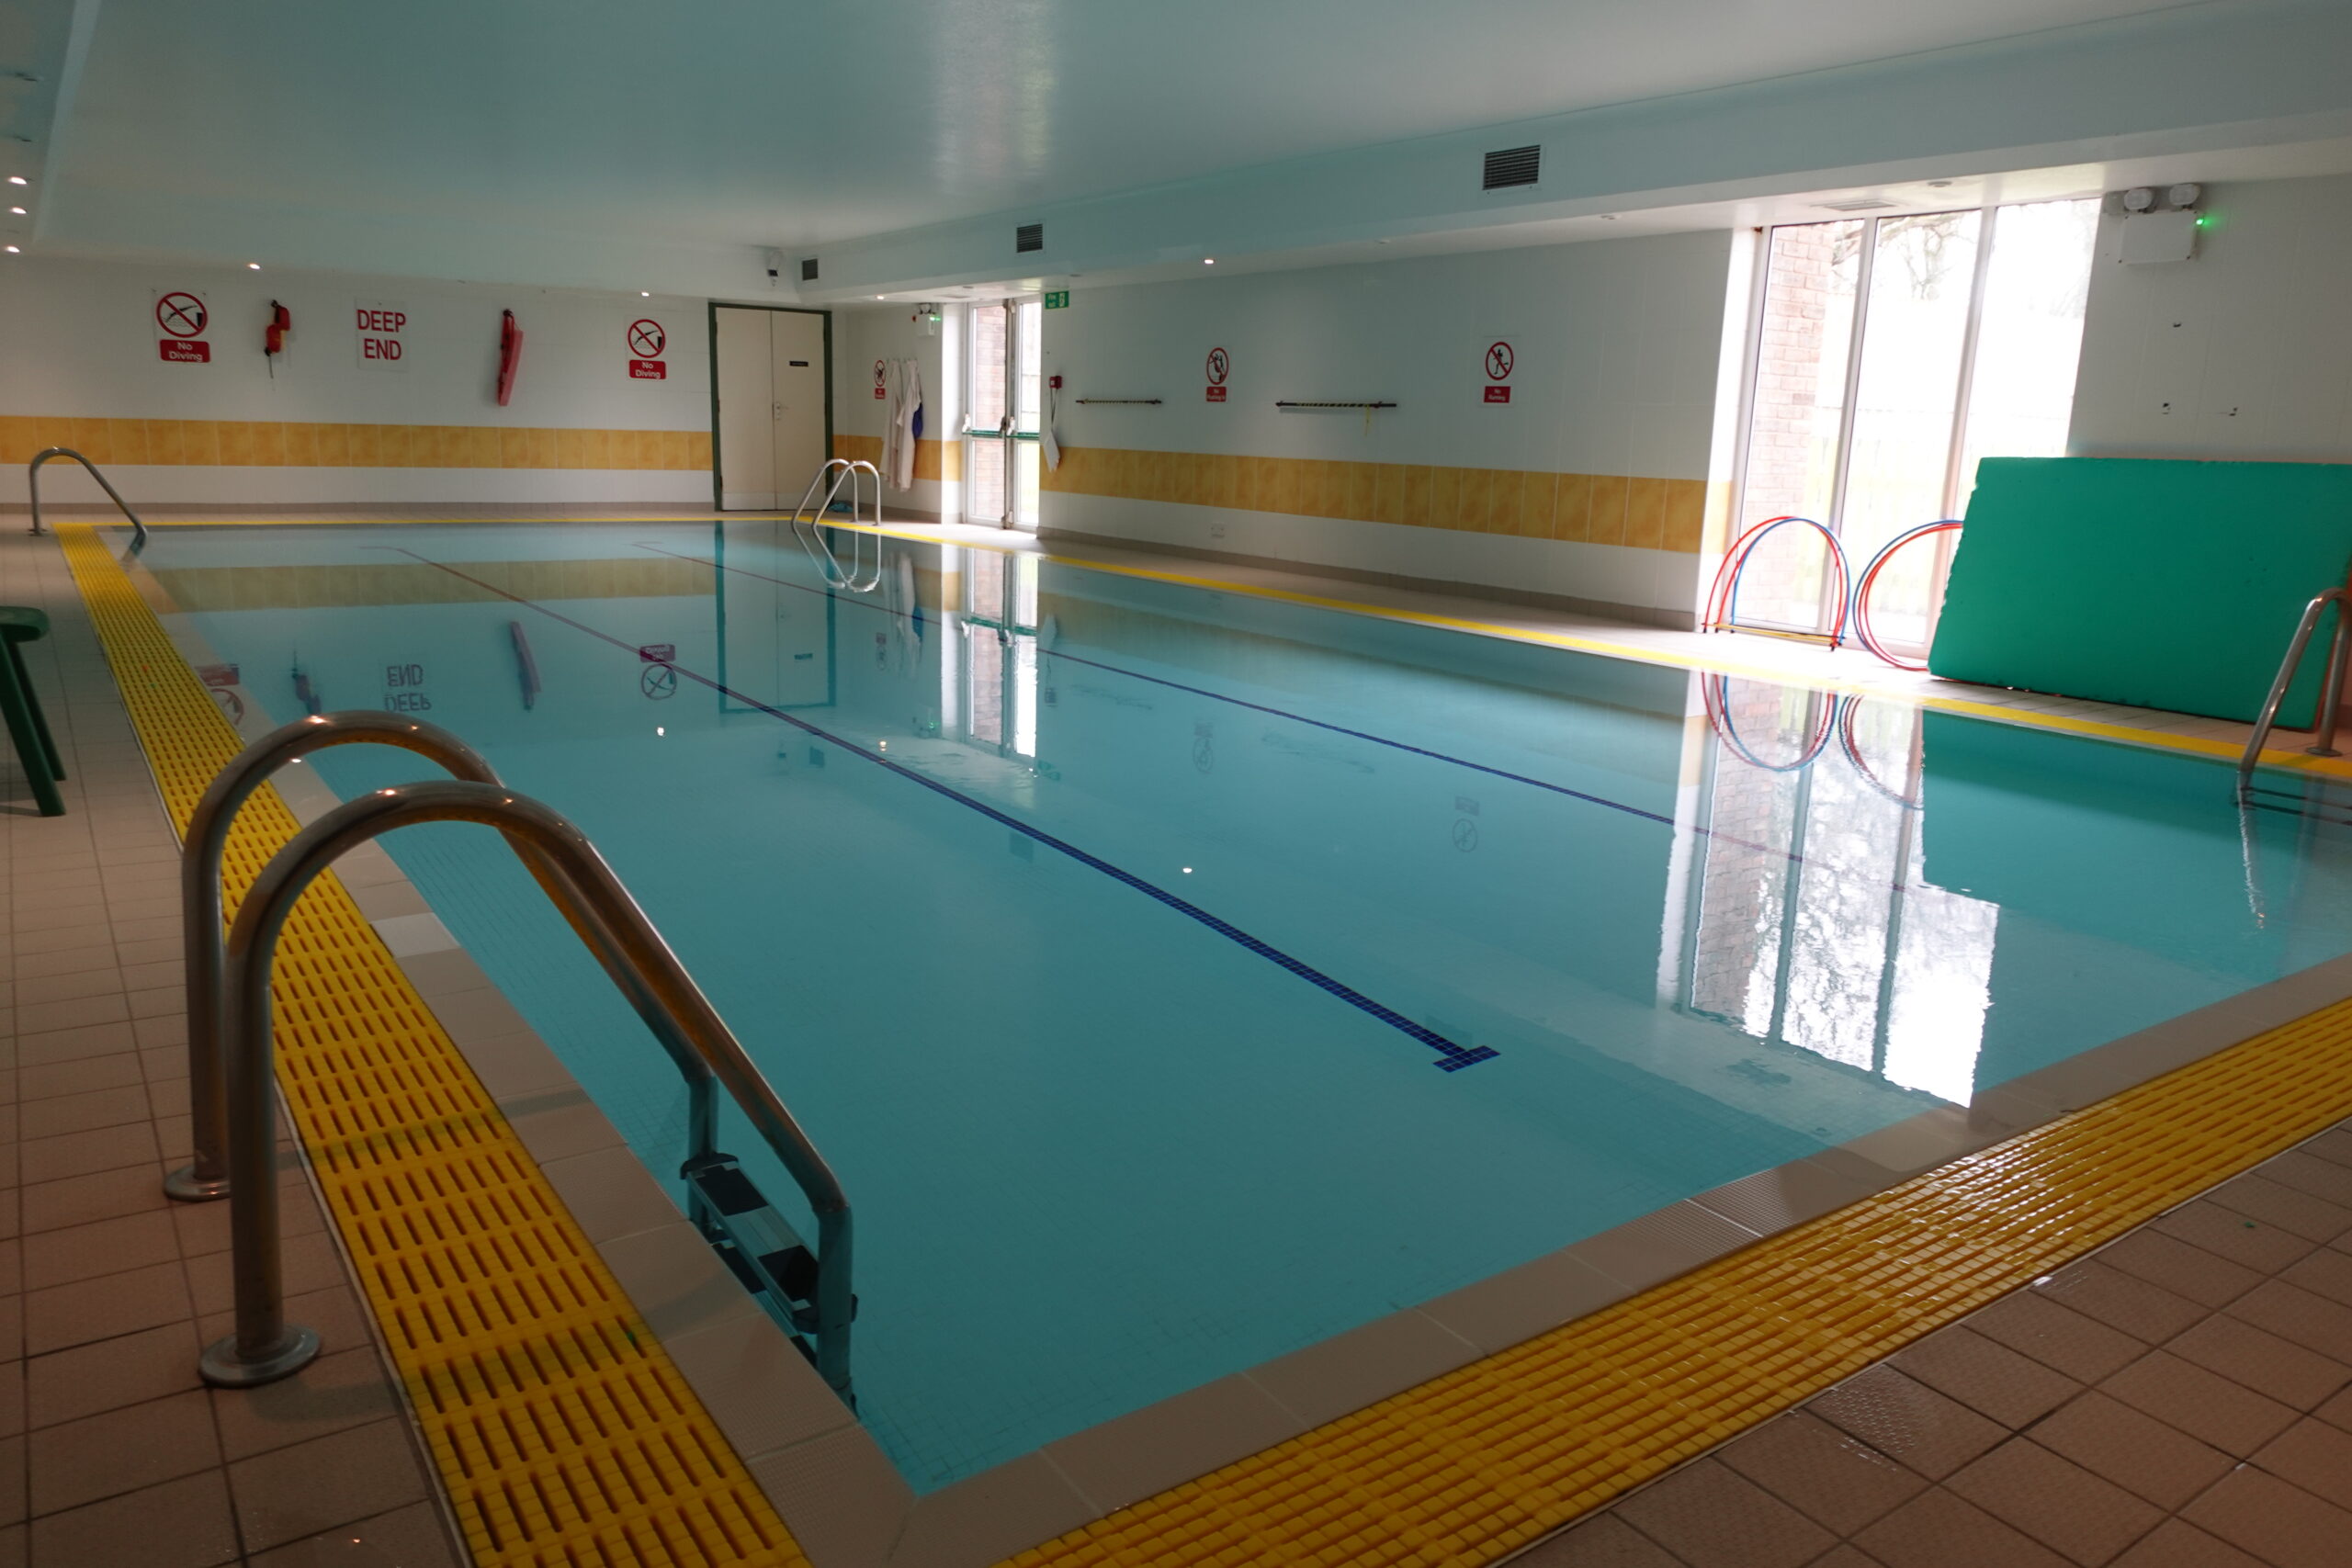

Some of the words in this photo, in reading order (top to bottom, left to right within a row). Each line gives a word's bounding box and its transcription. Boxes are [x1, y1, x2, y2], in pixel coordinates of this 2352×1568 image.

[356, 309, 406, 333] DEEP
[176, 341, 193, 350] No
[364, 338, 402, 360] END
[168, 351, 203, 363] Diving
[641, 361, 654, 369] No
[635, 368, 661, 379] Diving
